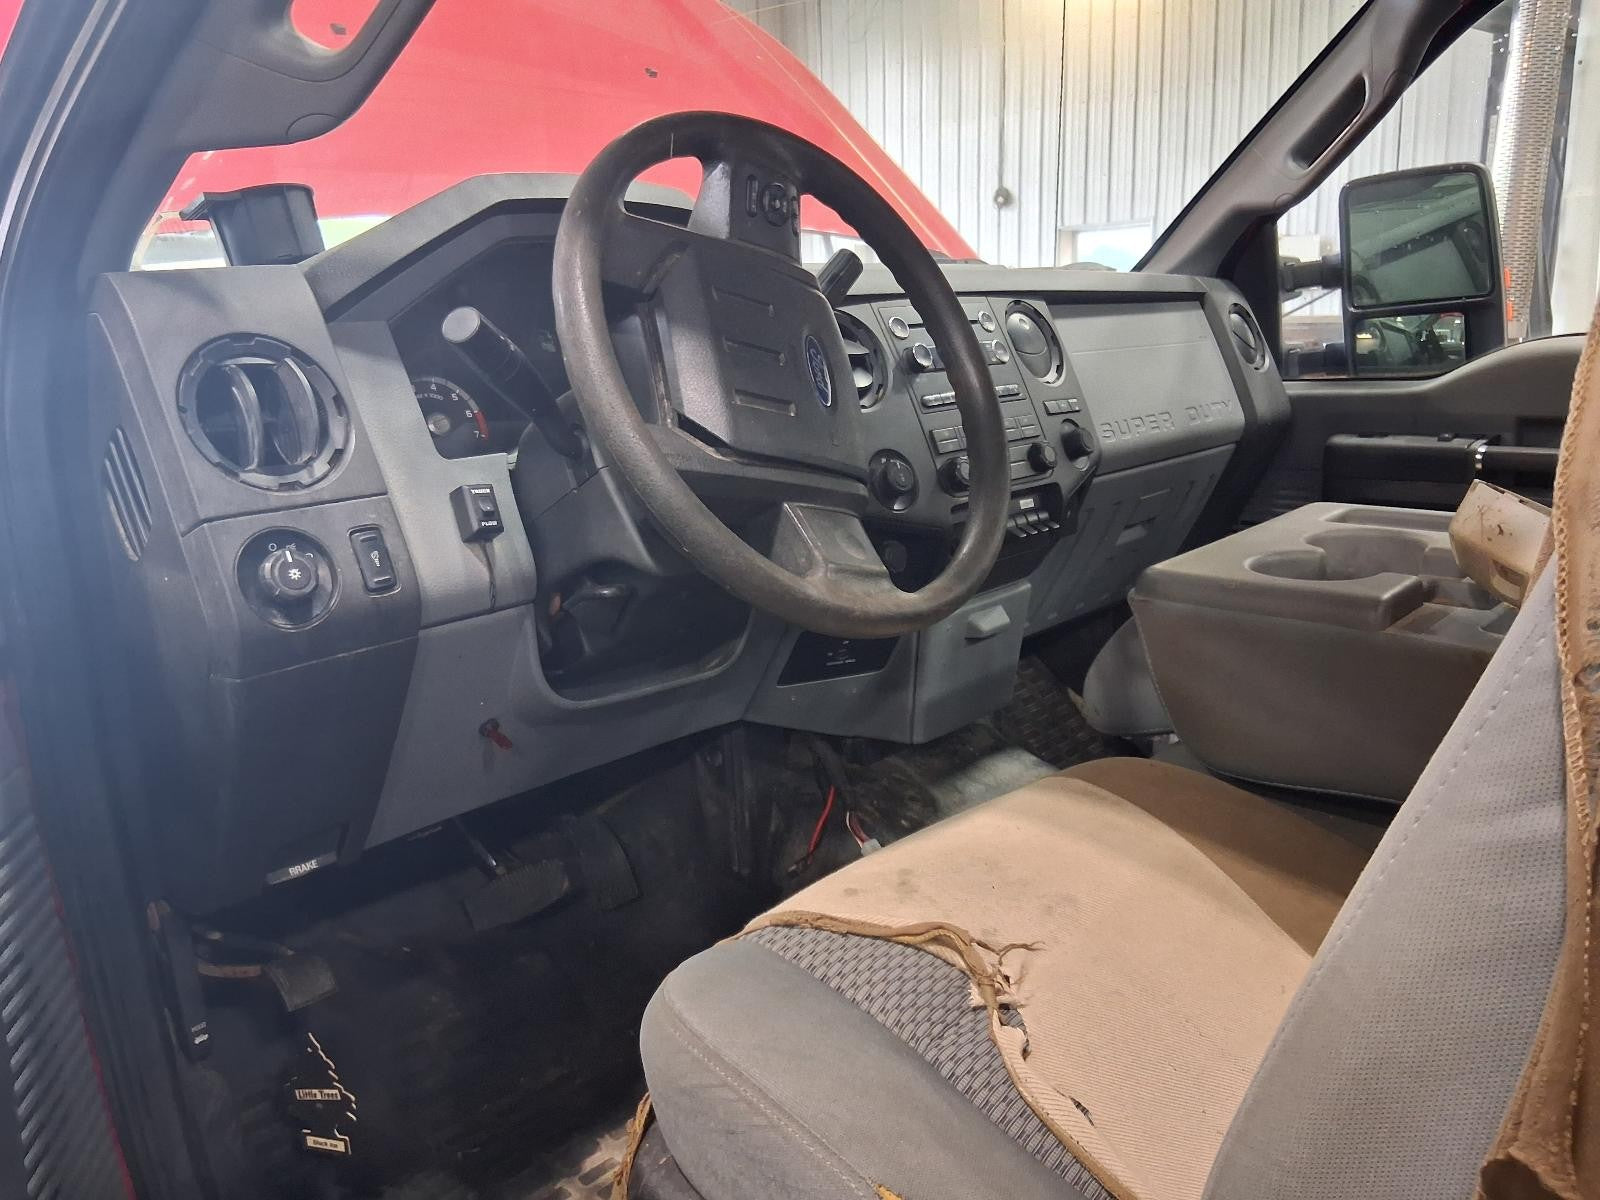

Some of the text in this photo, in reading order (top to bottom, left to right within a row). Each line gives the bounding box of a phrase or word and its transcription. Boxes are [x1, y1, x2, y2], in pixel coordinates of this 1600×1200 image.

[430, 383, 437, 391] 4
[451, 393, 459, 401] 5
[465, 410, 473, 418] 6
[1100, 400, 1233, 442] SUPER DUTY
[473, 430, 480, 438] 7
[288, 859, 319, 877] BRAKE
[298, 1089, 339, 1099] Little Trees
